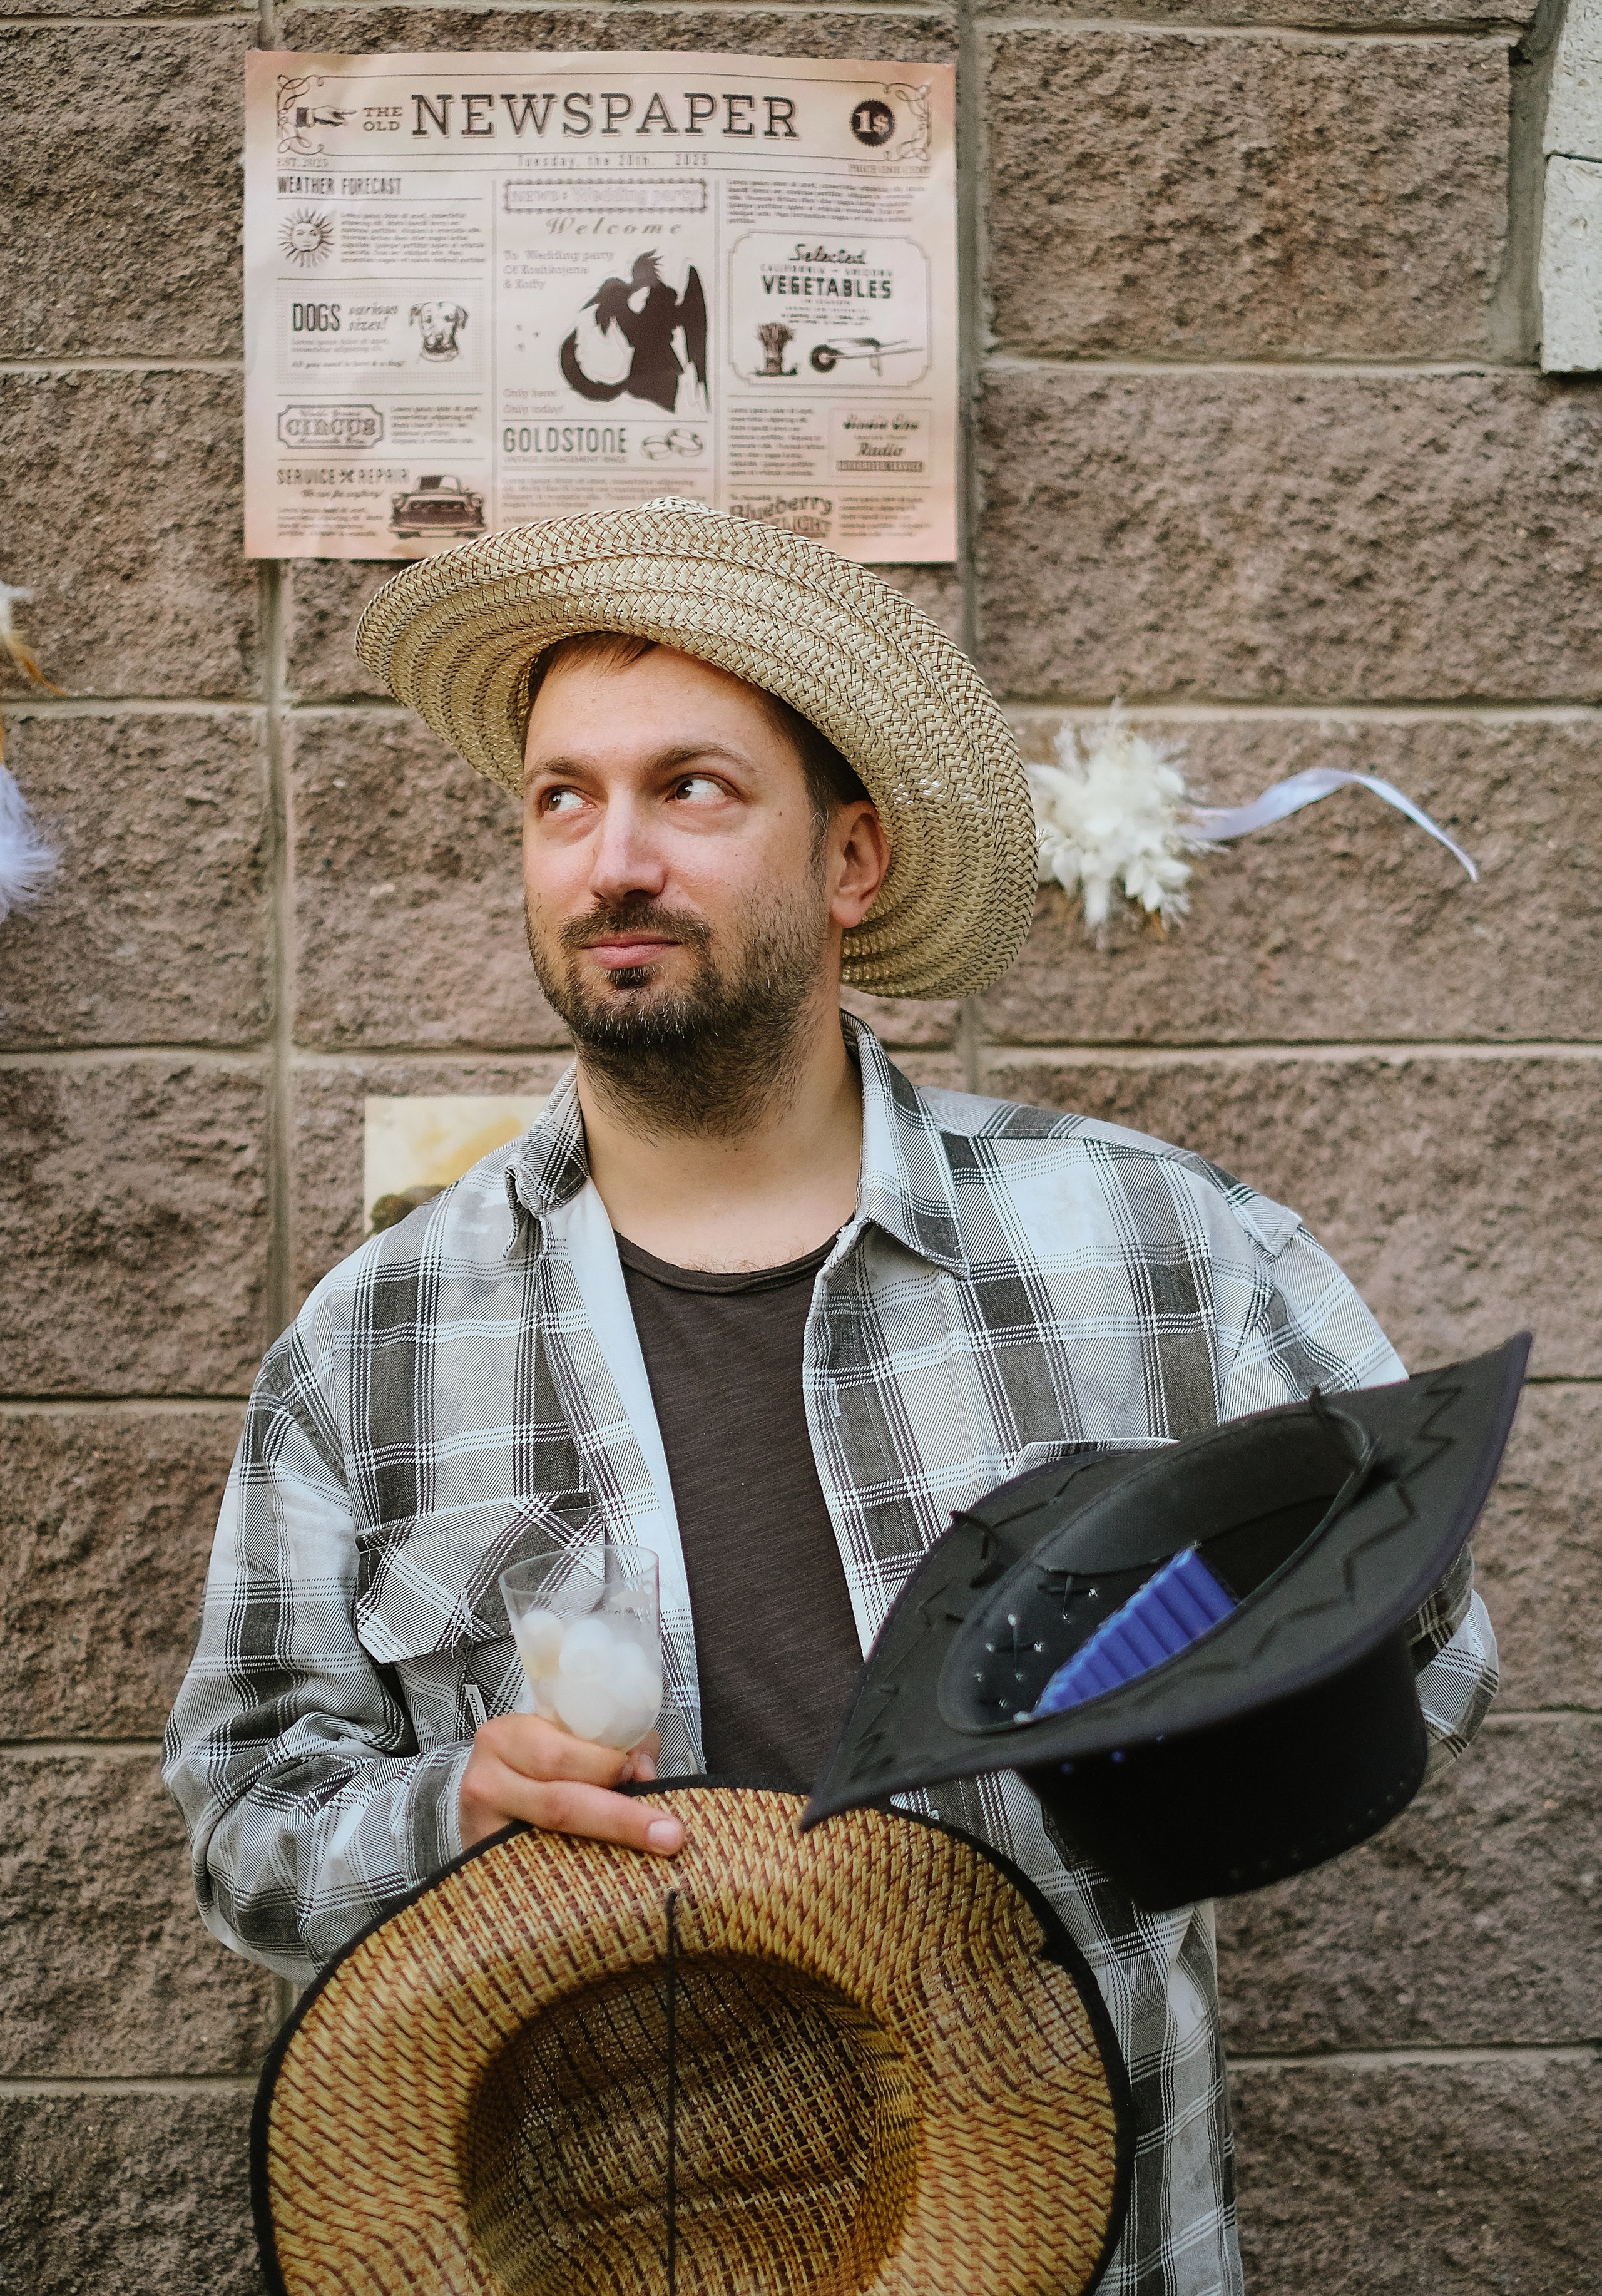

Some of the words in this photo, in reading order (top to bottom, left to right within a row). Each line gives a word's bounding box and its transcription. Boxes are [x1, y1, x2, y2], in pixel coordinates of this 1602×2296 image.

[362, 106, 403, 118] THE
[411, 91, 799, 140] NEWSPAPER
[362, 121, 401, 132] OLD
[587, 155, 610, 167] the
[277, 176, 335, 195] WEATHER
[341, 177, 402, 195] FORECAST
[544, 217, 682, 235] Welcome
[582, 252, 615, 262] party
[787, 243, 867, 265] Selected
[760, 274, 892, 299] VEGETABLES
[292, 302, 340, 332] DOGS
[285, 418, 376, 436] CIRCUS
[503, 426, 627, 453] GOLDSTONE
[277, 468, 335, 485] SERVICE
[358, 468, 411, 484] REPAIR
[730, 495, 833, 521] Blueberry
